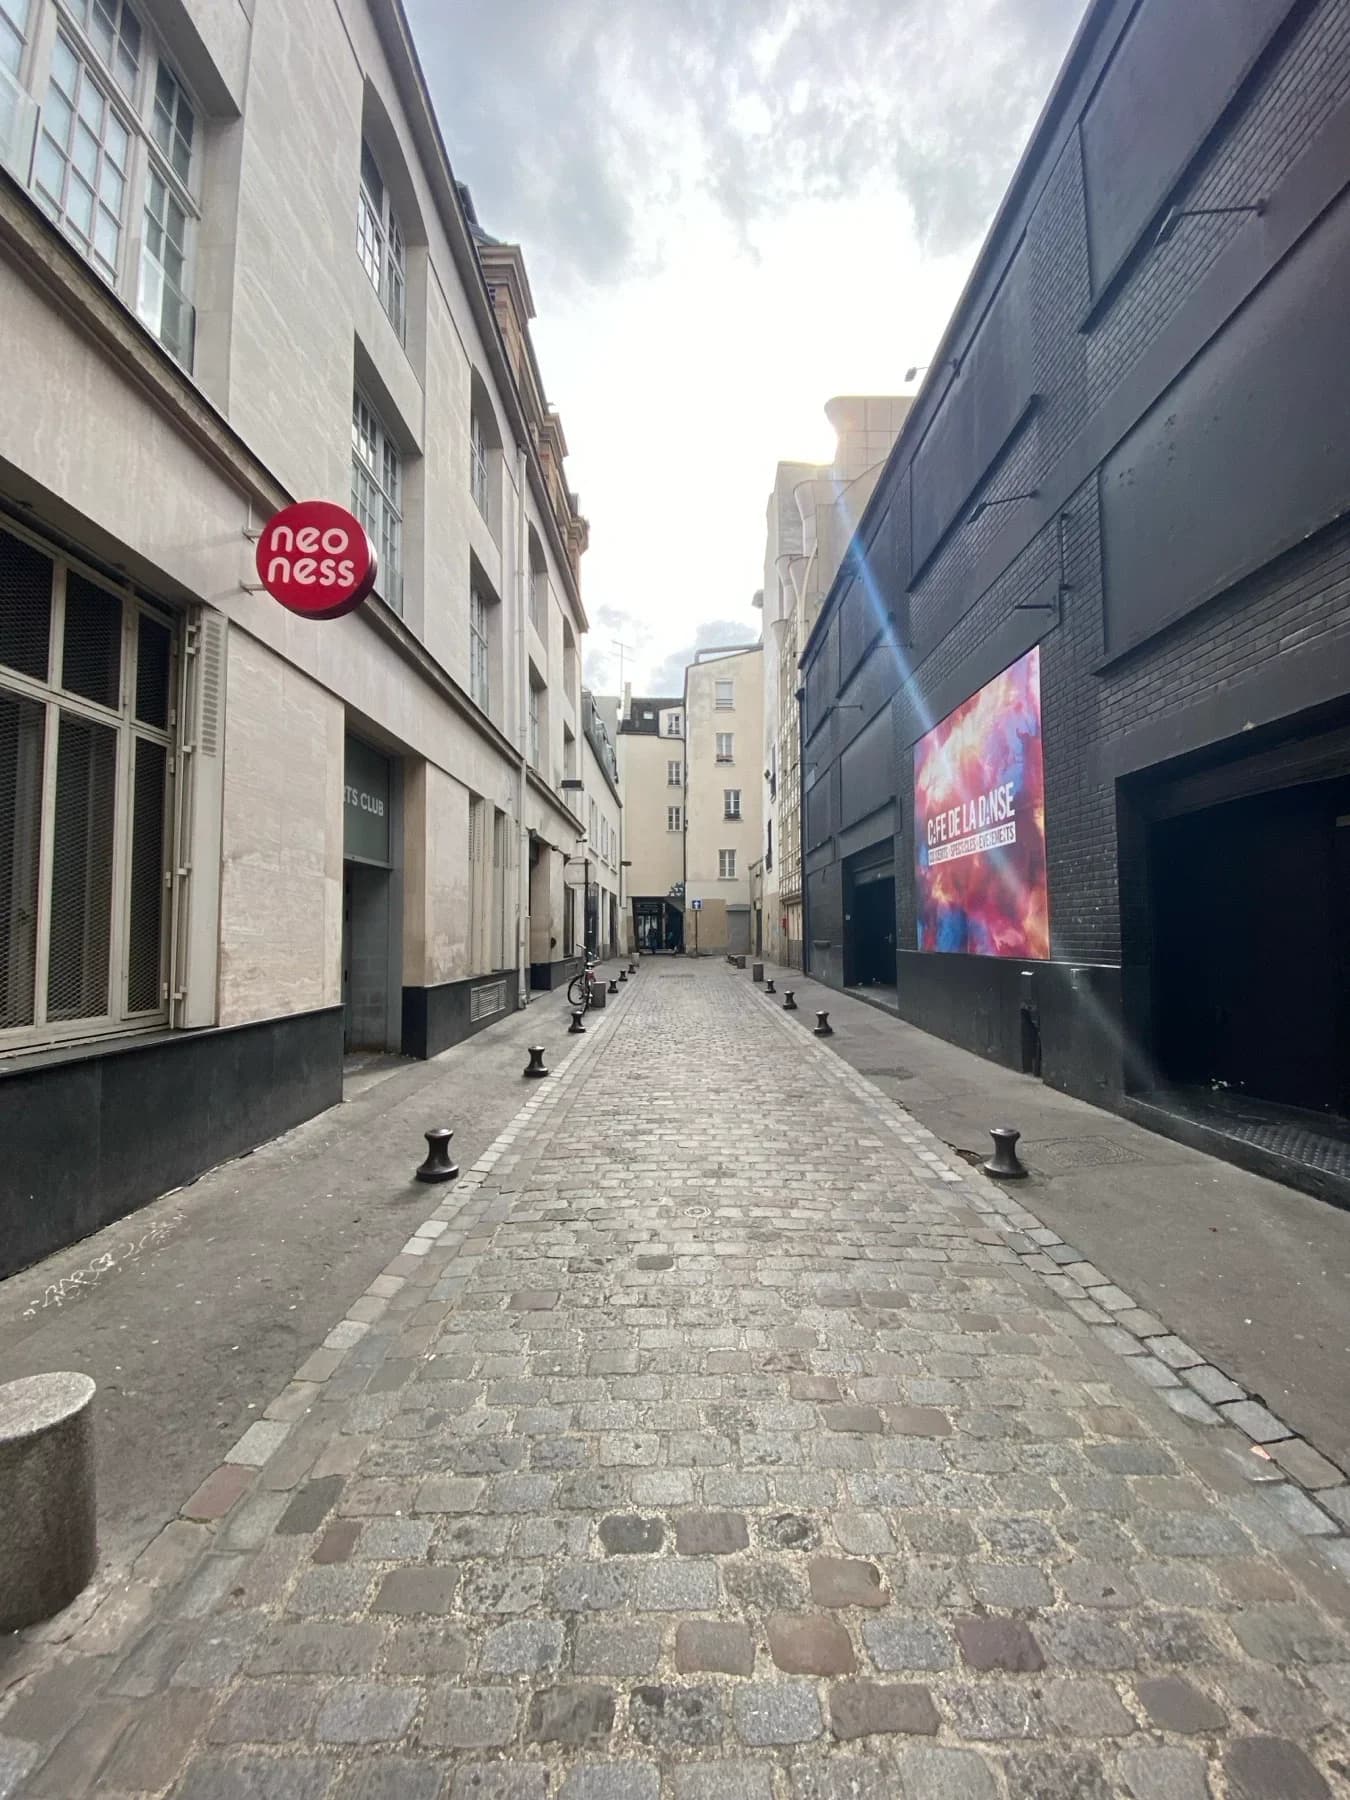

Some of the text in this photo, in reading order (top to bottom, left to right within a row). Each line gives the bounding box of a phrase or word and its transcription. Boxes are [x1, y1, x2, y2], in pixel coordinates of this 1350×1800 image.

[270, 526, 349, 554] neo
[267, 556, 355, 587] ness
[344, 785, 384, 817] TS CLUB
[948, 806, 961, 838] DE
[962, 800, 977, 833] LA
[978, 781, 1015, 827] DANSE
